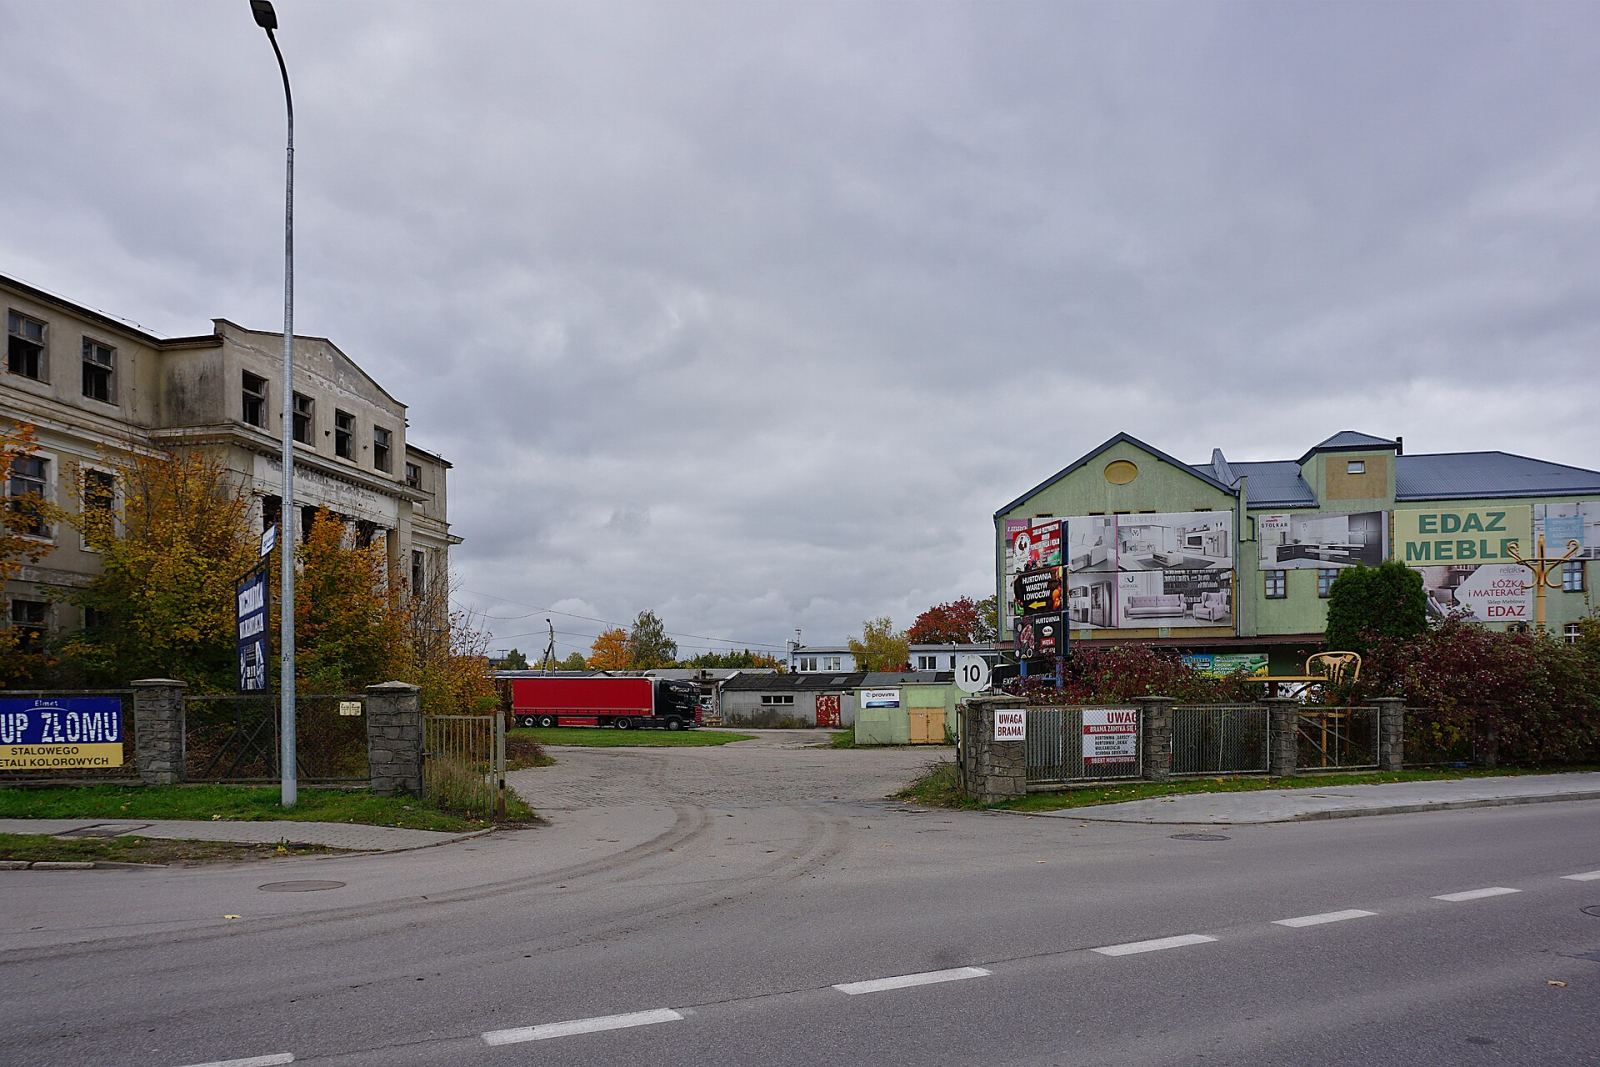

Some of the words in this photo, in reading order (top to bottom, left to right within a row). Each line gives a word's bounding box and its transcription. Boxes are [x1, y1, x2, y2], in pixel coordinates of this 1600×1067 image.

[1418, 512, 1507, 534] EDAZ
[1405, 538, 1520, 561] MEBLE
[1022, 572, 1052, 585] HURTOWNIA
[1492, 578, 1525, 588] ŁÓŻKA
[1025, 581, 1049, 592] WARZYW
[1026, 589, 1051, 600] OWOCÓW
[1473, 588, 1526, 597] MATERACE
[1487, 605, 1526, 617] EDAZ
[962, 664, 980, 682] 10
[998, 714, 1023, 724] UWAGA
[41, 711, 118, 743] ZŁOMU
[997, 726, 1024, 736] BRAMA!
[11, 746, 79, 756] STALOWEGO
[30, 757, 109, 767] KOLOROWYCH
